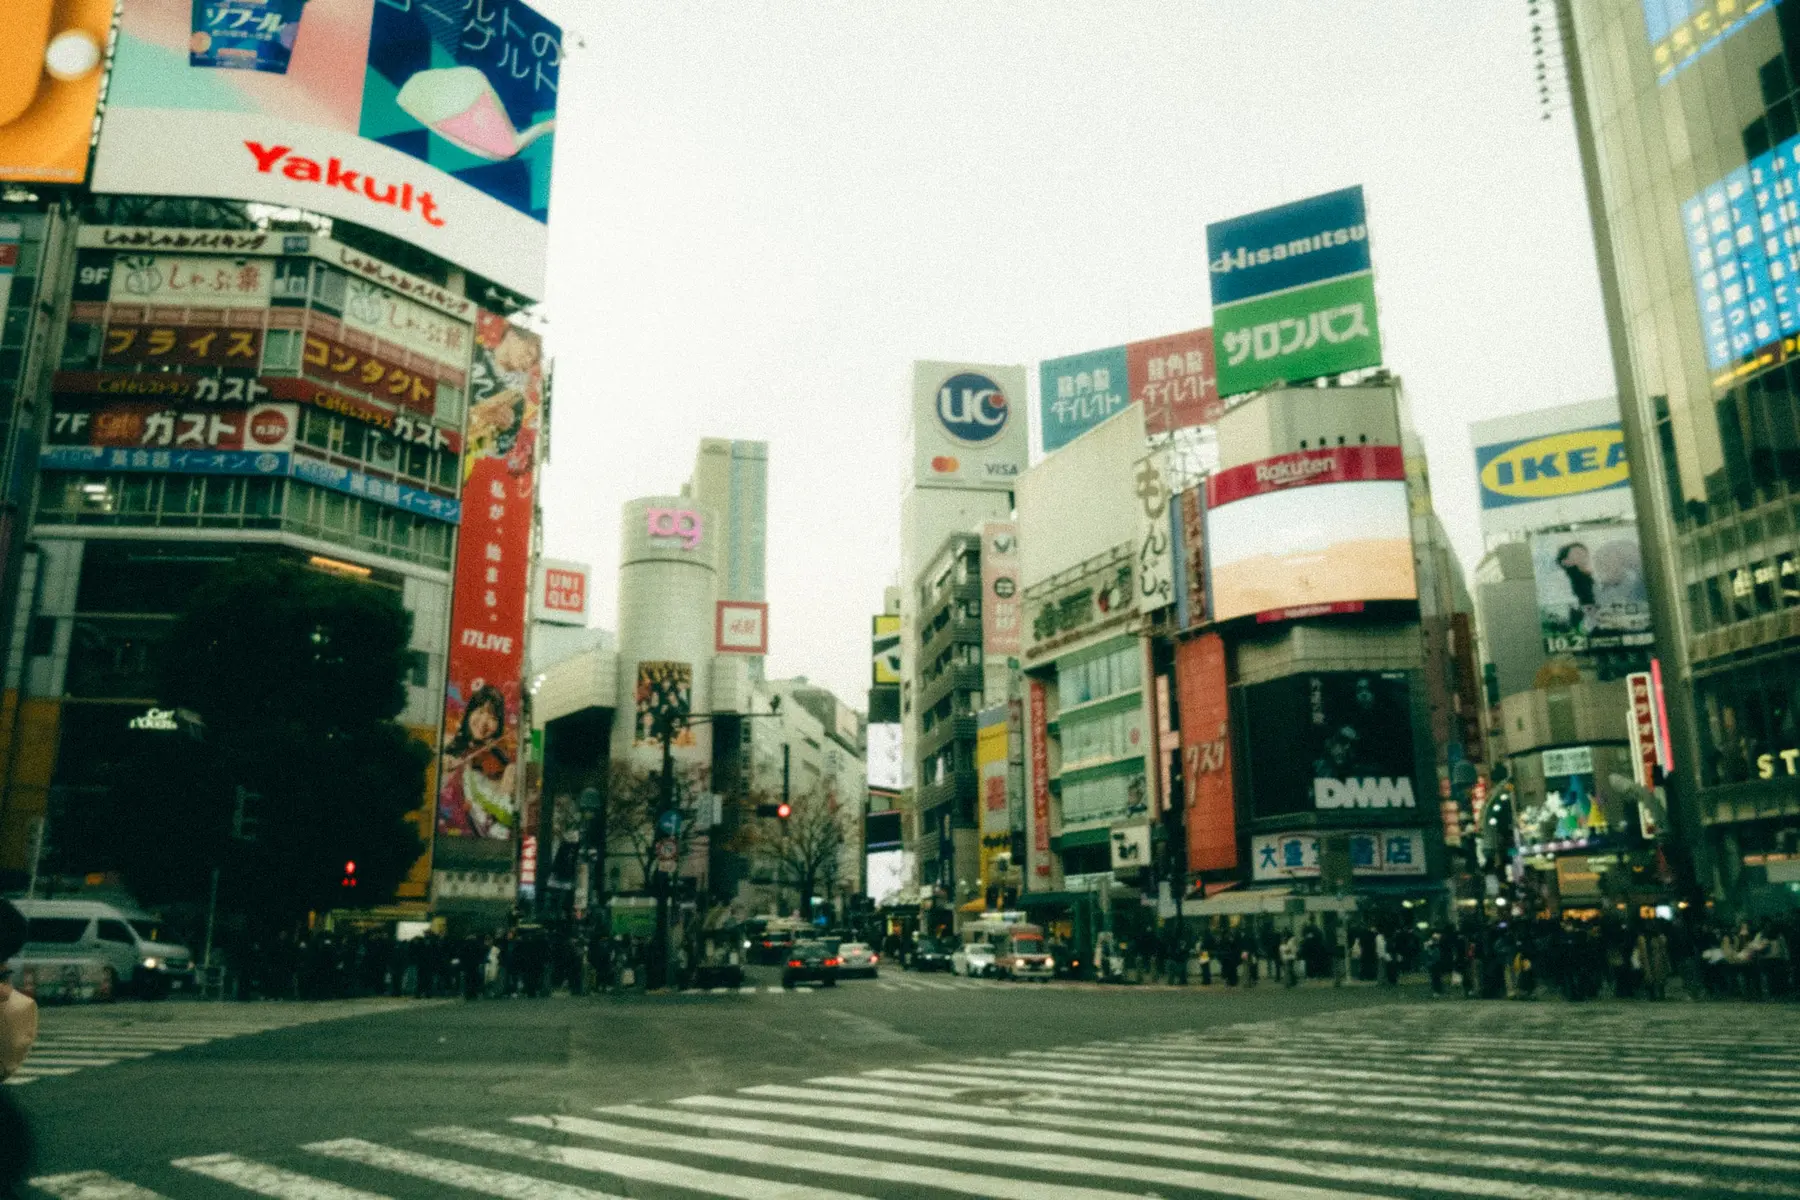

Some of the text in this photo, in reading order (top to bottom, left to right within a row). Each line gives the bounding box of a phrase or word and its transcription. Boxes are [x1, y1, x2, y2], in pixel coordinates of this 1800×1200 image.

[206, 7, 286, 33] ソフール
[379, 0, 558, 93] ーグルト
[244, 140, 446, 228] Yakult
[103, 229, 267, 250] しゃぶしゃぶバイキング
[1209, 224, 1367, 273] Hisamitsu
[80, 267, 110, 285] 9F
[1222, 302, 1369, 367] サロンパス
[303, 336, 432, 402] コンタクト
[940, 386, 1006, 426] UC
[54, 413, 90, 433] 7F
[142, 411, 237, 446] ガスト
[984, 463, 1019, 476] VISA
[1256, 456, 1338, 482] Rakuten
[1496, 441, 1629, 487] IKEA
[550, 573, 579, 590] UNI
[548, 590, 582, 609] QLO
[461, 629, 514, 655] 17LIVE
[1757, 748, 1800, 780] ST
[1313, 776, 1416, 810] DMM
